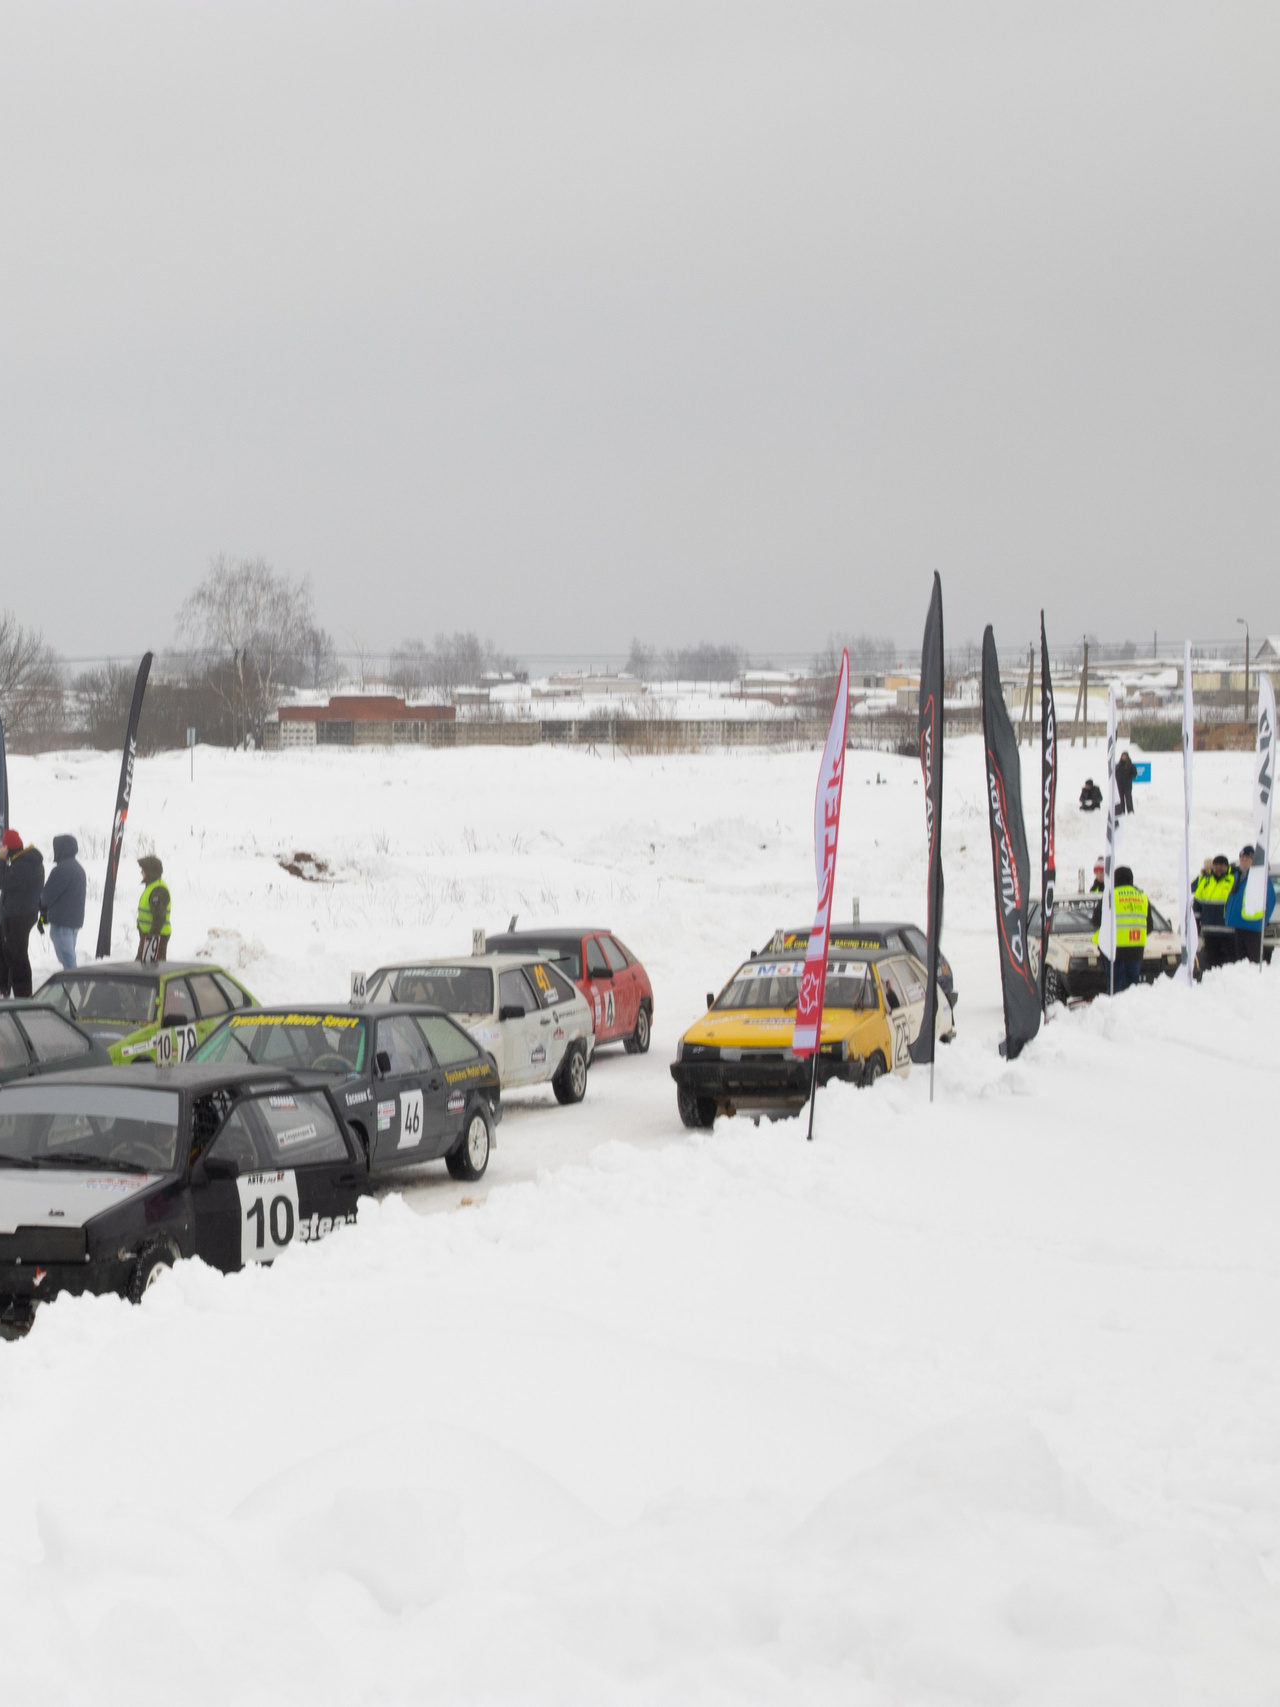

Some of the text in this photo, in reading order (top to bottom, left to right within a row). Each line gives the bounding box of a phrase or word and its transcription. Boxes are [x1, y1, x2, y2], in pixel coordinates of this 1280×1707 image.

[123, 733, 137, 803] MSK
[988, 772, 1017, 917] YUKA ADV
[143, 937, 160, 962] 79
[834, 939, 860, 949] RACING
[860, 940, 880, 950] TEAM
[352, 976, 365, 997] 46
[283, 1014, 322, 1027] Motor
[322, 1014, 360, 1029] Sport
[157, 1034, 171, 1061] 10
[404, 1101, 420, 1135] 46
[246, 1195, 295, 1250] 10
